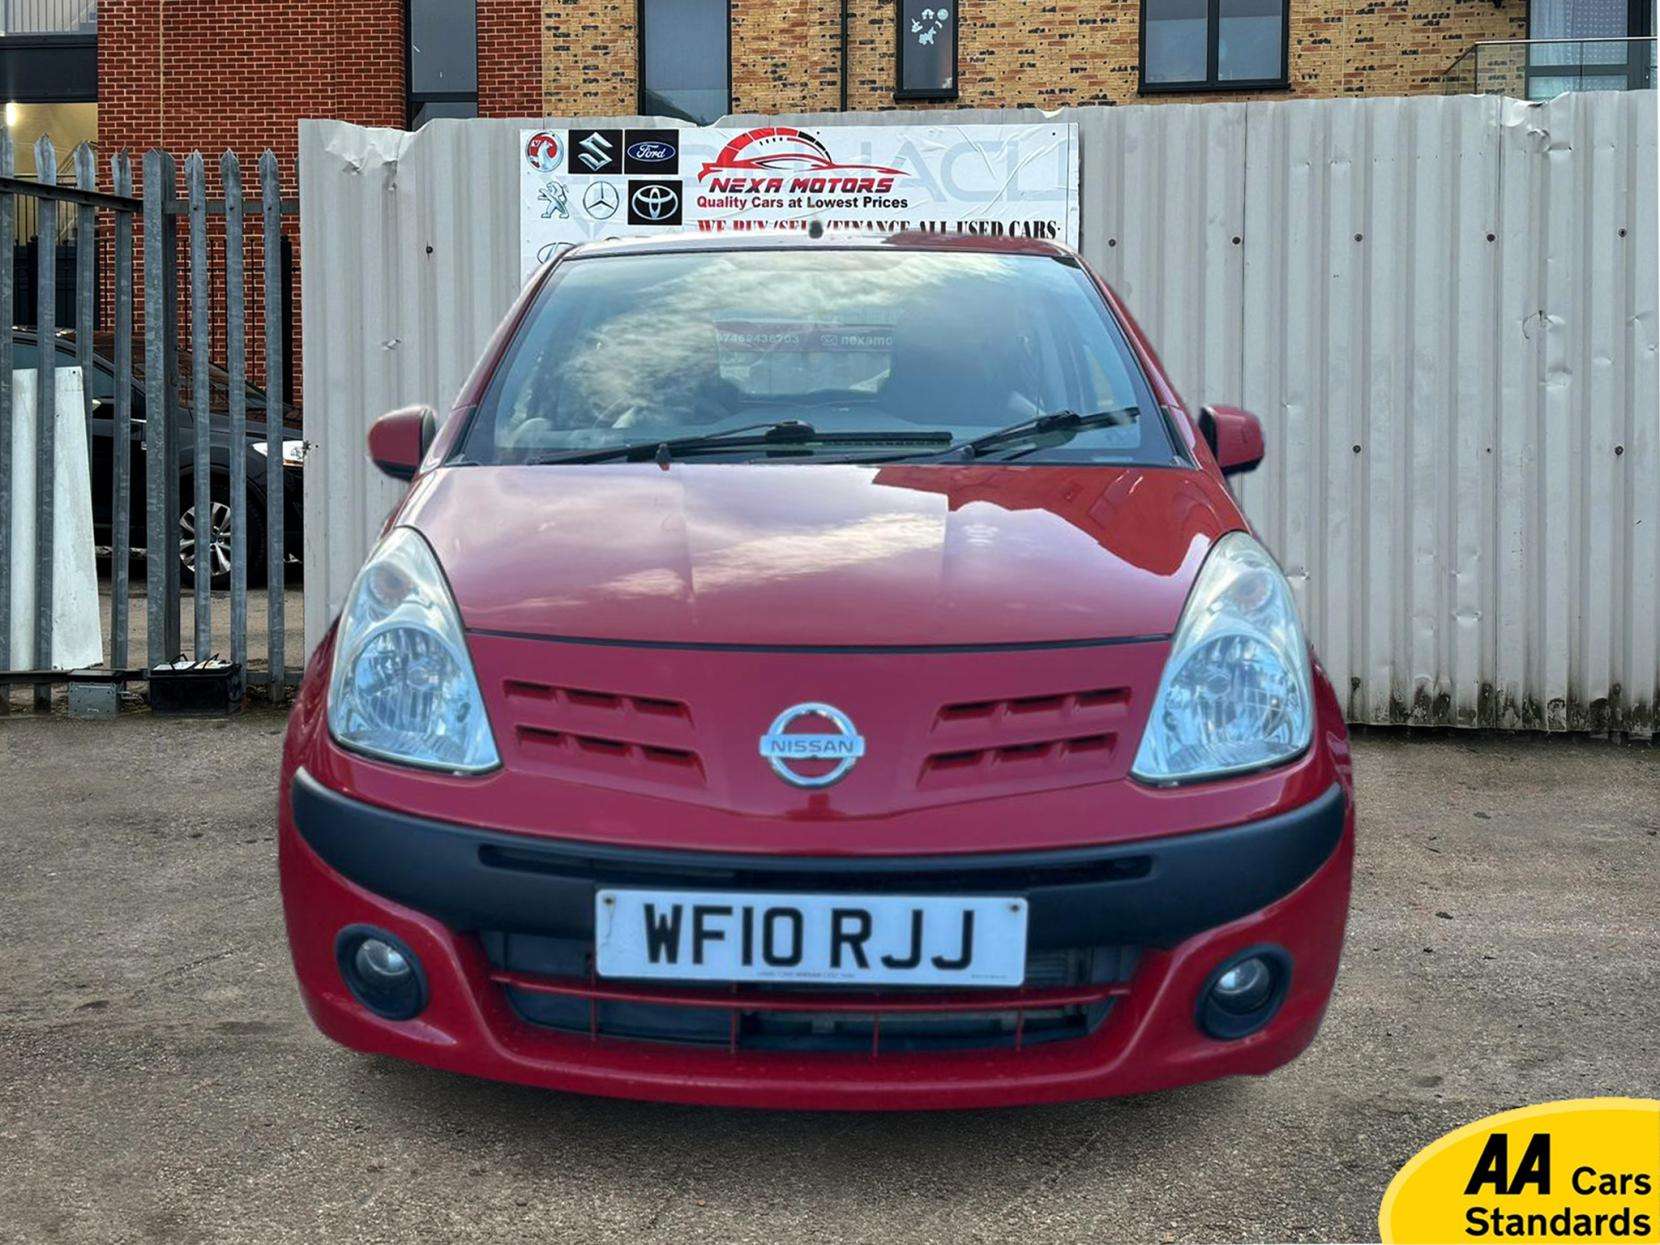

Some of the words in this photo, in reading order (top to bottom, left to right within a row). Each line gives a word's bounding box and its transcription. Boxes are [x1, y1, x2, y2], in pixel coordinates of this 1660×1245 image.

[636, 144, 666, 158] Ford
[709, 177, 784, 194] NEXA
[788, 177, 895, 194] MOTORS
[696, 196, 747, 210] Quality
[751, 196, 784, 208] Cars
[788, 197, 803, 208] at
[807, 196, 860, 208] Lowest
[863, 196, 908, 208] Prices
[957, 220, 1004, 236] USED
[771, 740, 855, 753] NISSAN
[643, 903, 804, 968] WF10
[830, 907, 975, 971] RJJ
